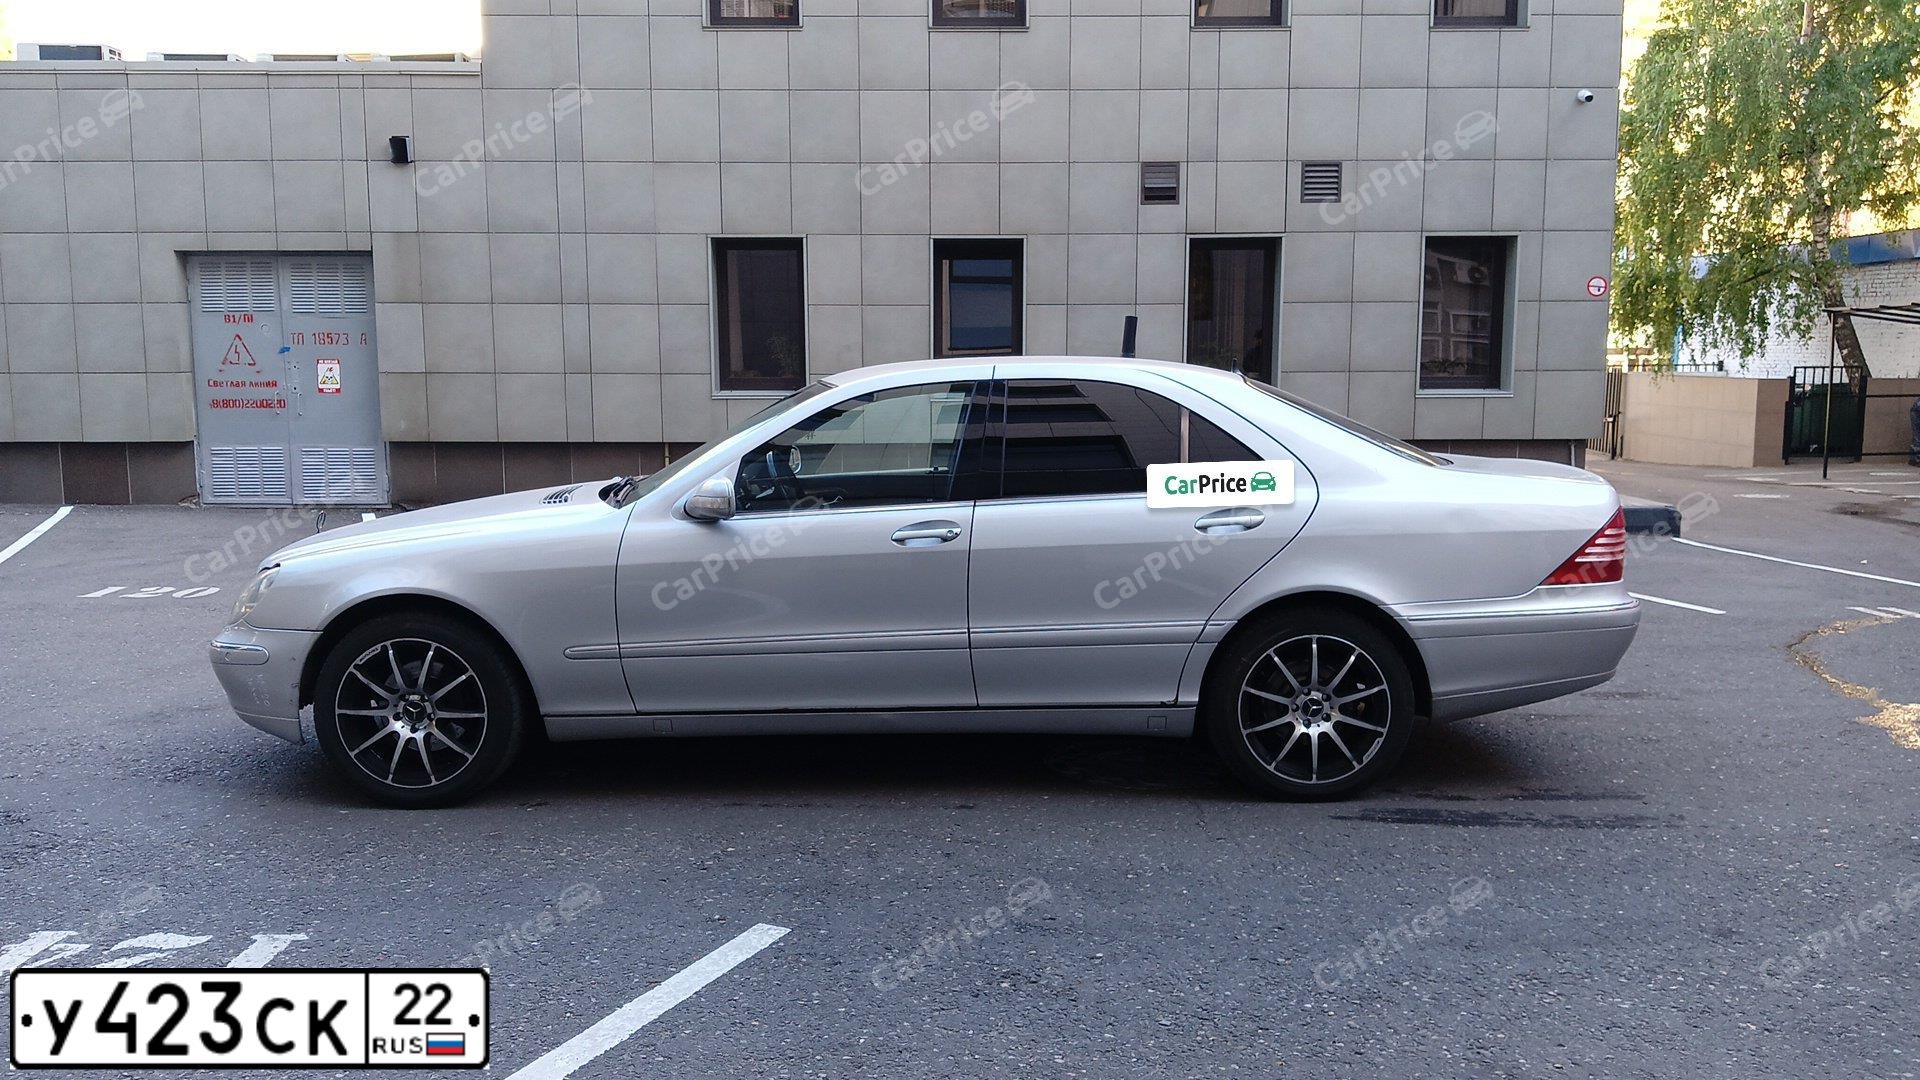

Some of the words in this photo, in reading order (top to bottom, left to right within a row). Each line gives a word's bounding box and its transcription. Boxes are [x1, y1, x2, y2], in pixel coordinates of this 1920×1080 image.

[207, 378, 247, 388] Светлая
[248, 379, 278, 388] линия
[76, 586, 221, 598] 120
